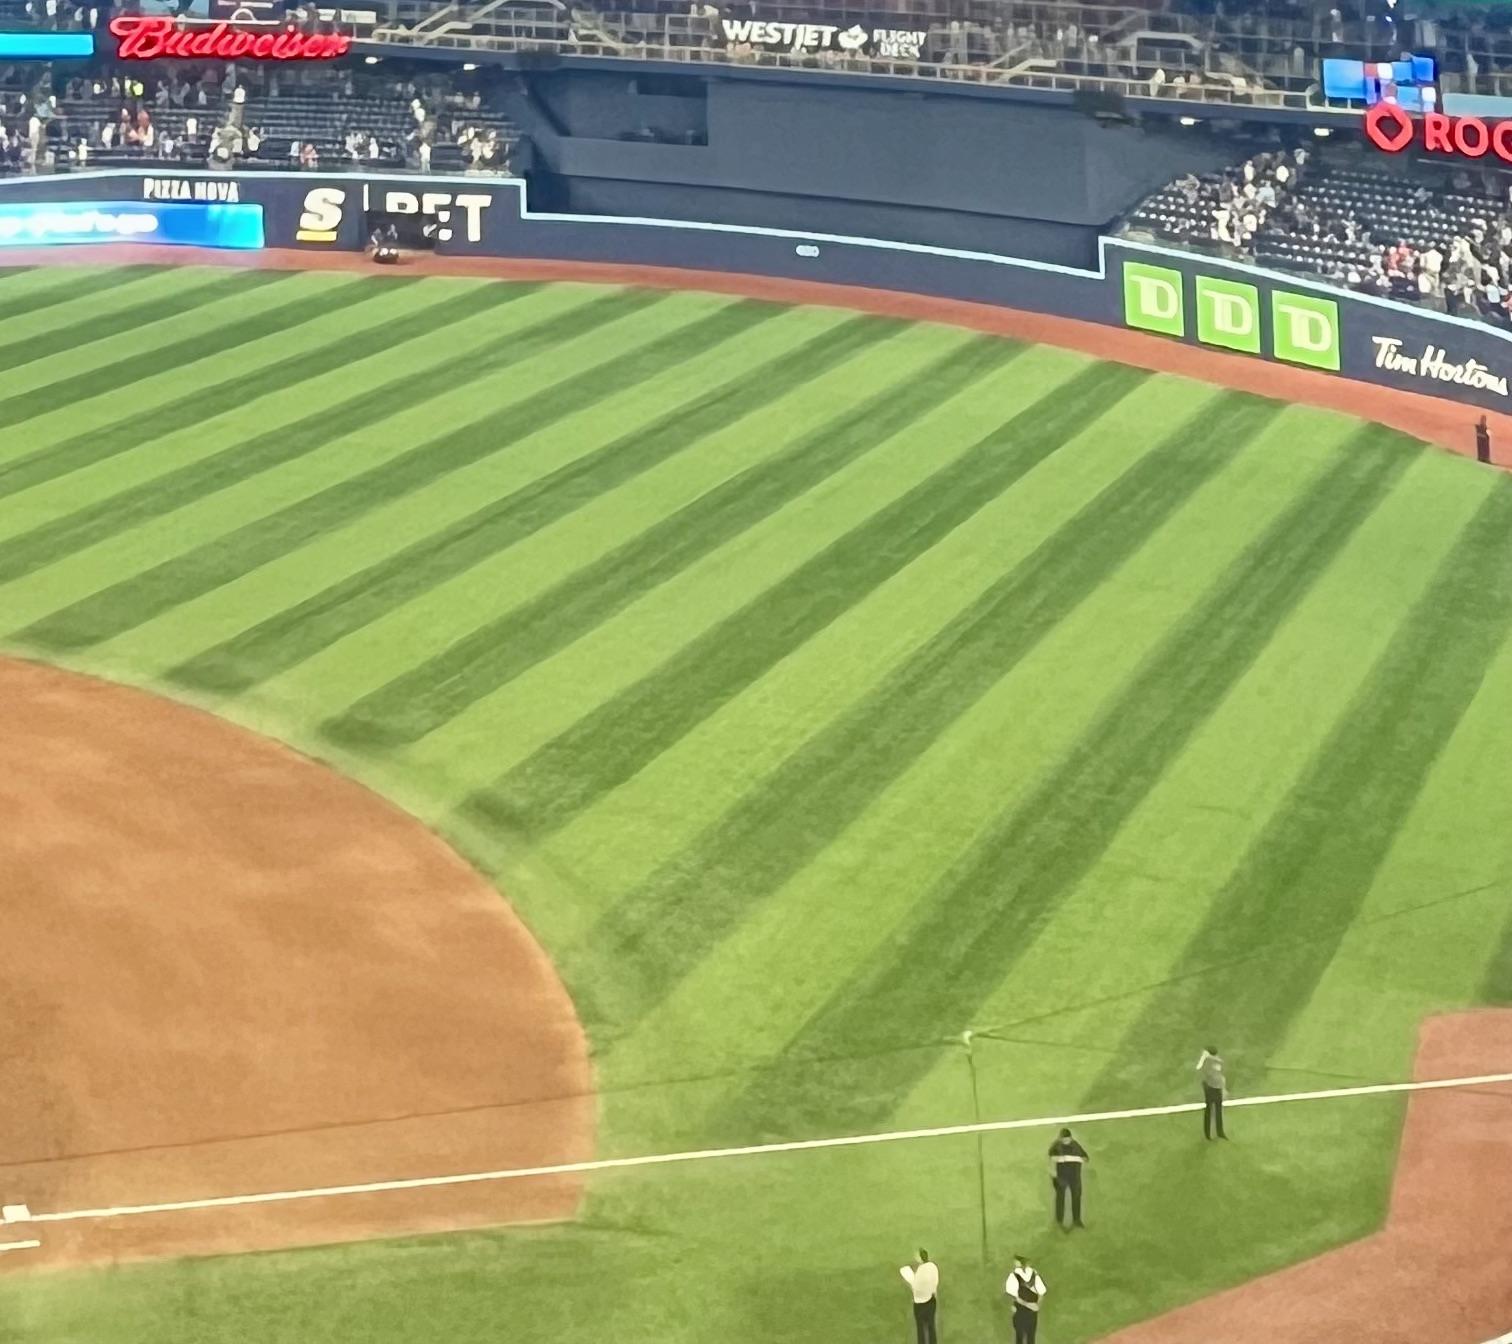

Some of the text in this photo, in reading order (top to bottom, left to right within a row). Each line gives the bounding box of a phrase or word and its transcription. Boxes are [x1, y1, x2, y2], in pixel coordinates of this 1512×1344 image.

[109, 16, 354, 59] Budweiser
[722, 19, 839, 49] WESTJET
[143, 177, 240, 203] PIZZA NOVA
[1128, 274, 1179, 320] TD
[1201, 288, 1254, 336] TD
[1277, 303, 1333, 353] TD
[1371, 335, 1418, 375] Tim
